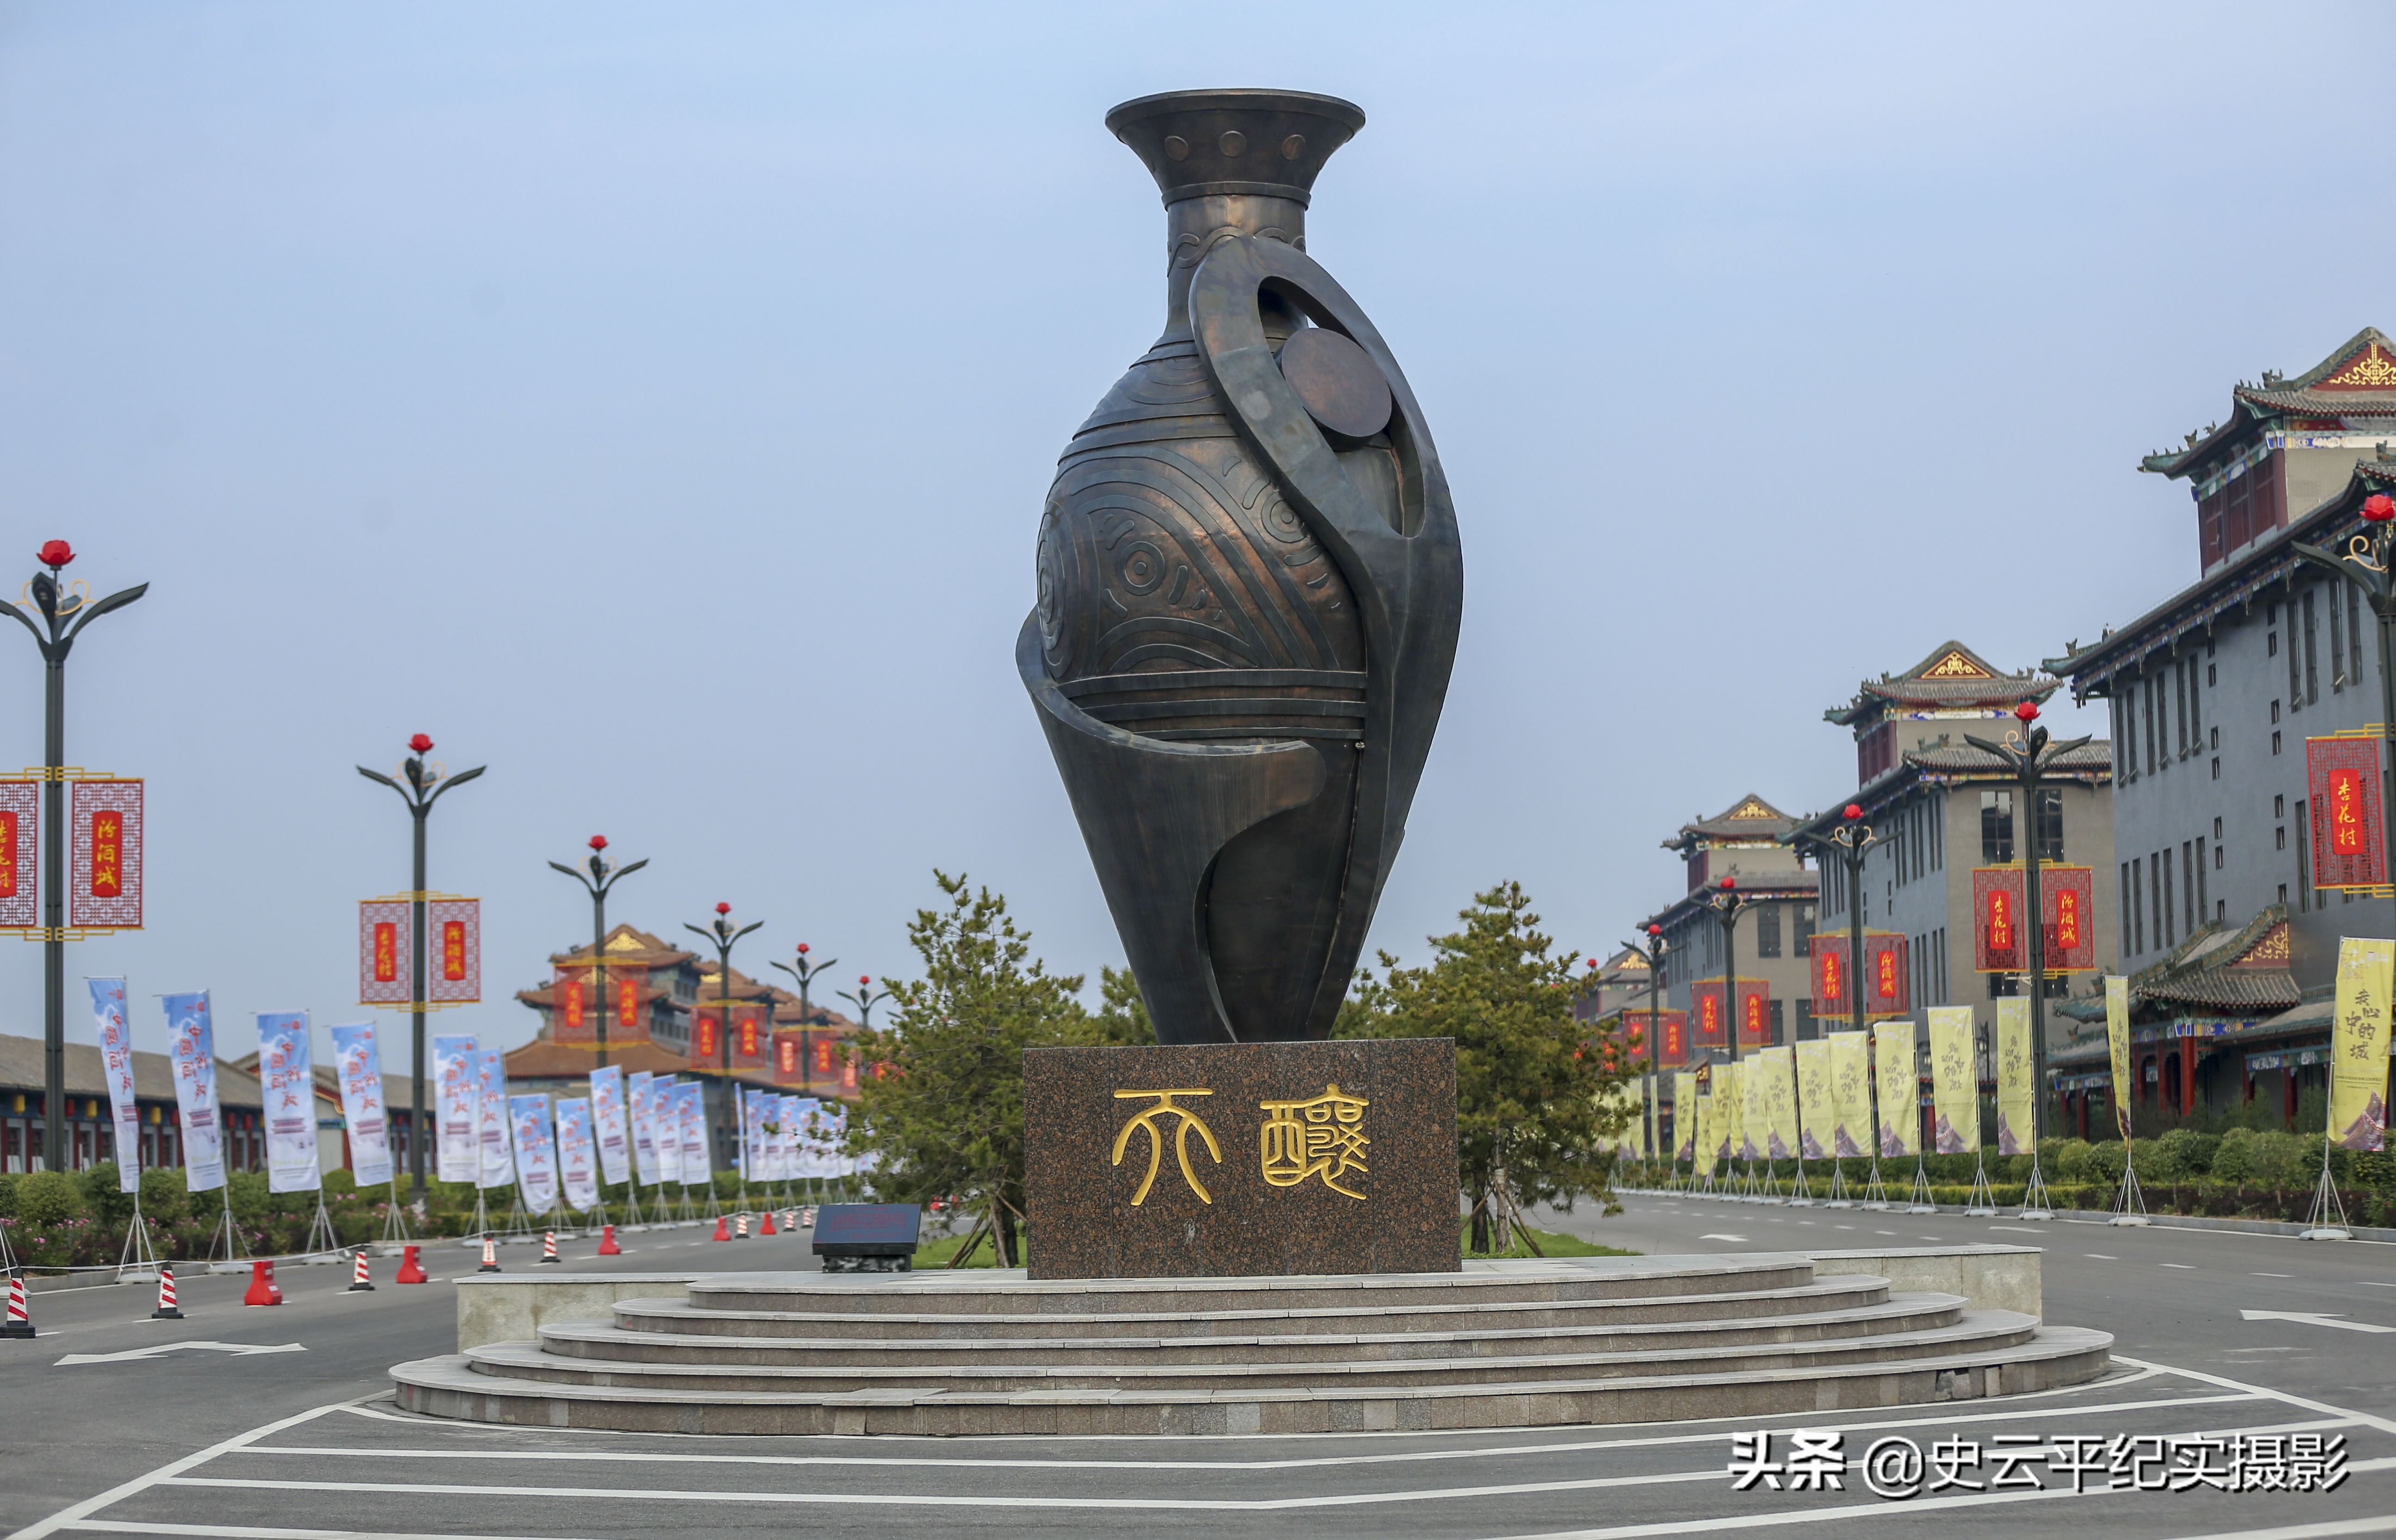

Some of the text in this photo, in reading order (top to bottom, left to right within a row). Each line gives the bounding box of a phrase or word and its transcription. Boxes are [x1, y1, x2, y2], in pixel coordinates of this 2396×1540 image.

[2338, 777, 2356, 846] 杏花村
[95, 819, 118, 889] 汾酒城
[1994, 895, 2007, 944] 杏花村
[2061, 895, 2077, 944] 汾酒城
[2345, 988, 2381, 1061] 我心中的城
